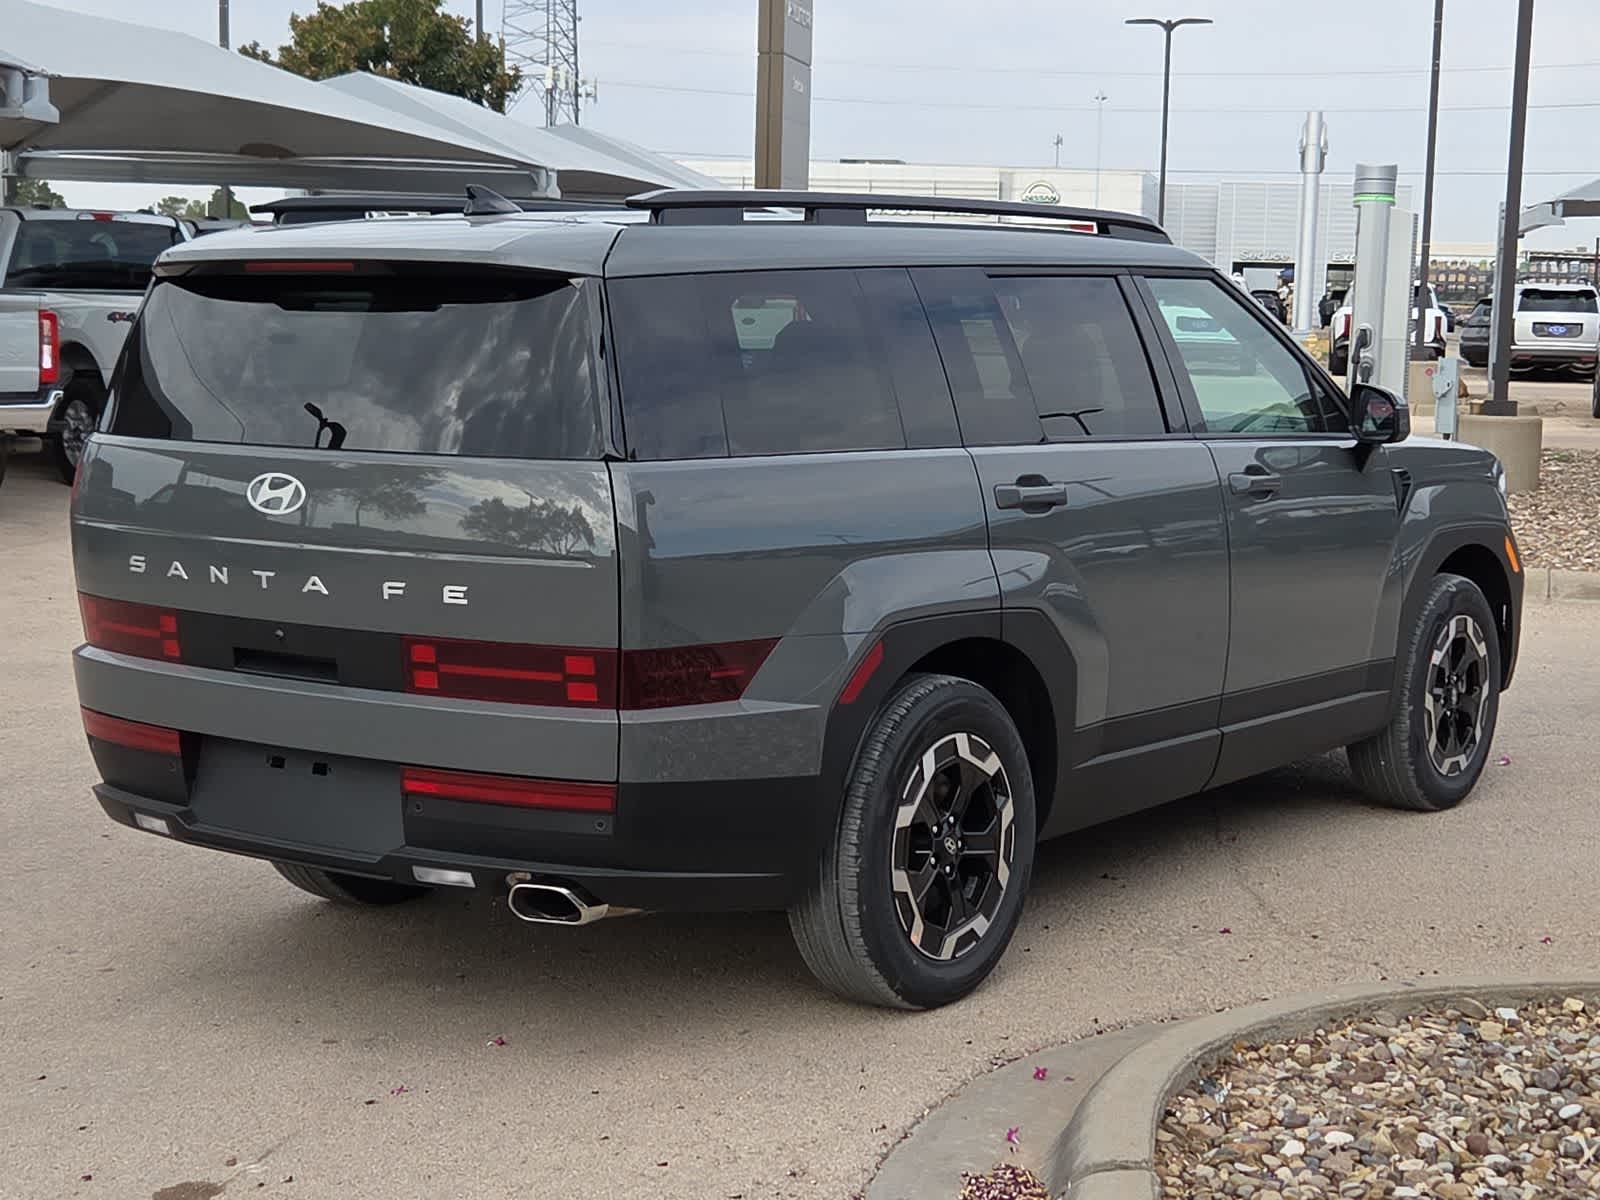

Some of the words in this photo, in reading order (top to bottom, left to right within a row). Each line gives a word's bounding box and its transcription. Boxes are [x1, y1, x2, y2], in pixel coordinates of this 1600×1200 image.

[1023, 193, 1057, 202] NISSAN
[128, 554, 330, 595] SANTA
[382, 581, 469, 605] FE
